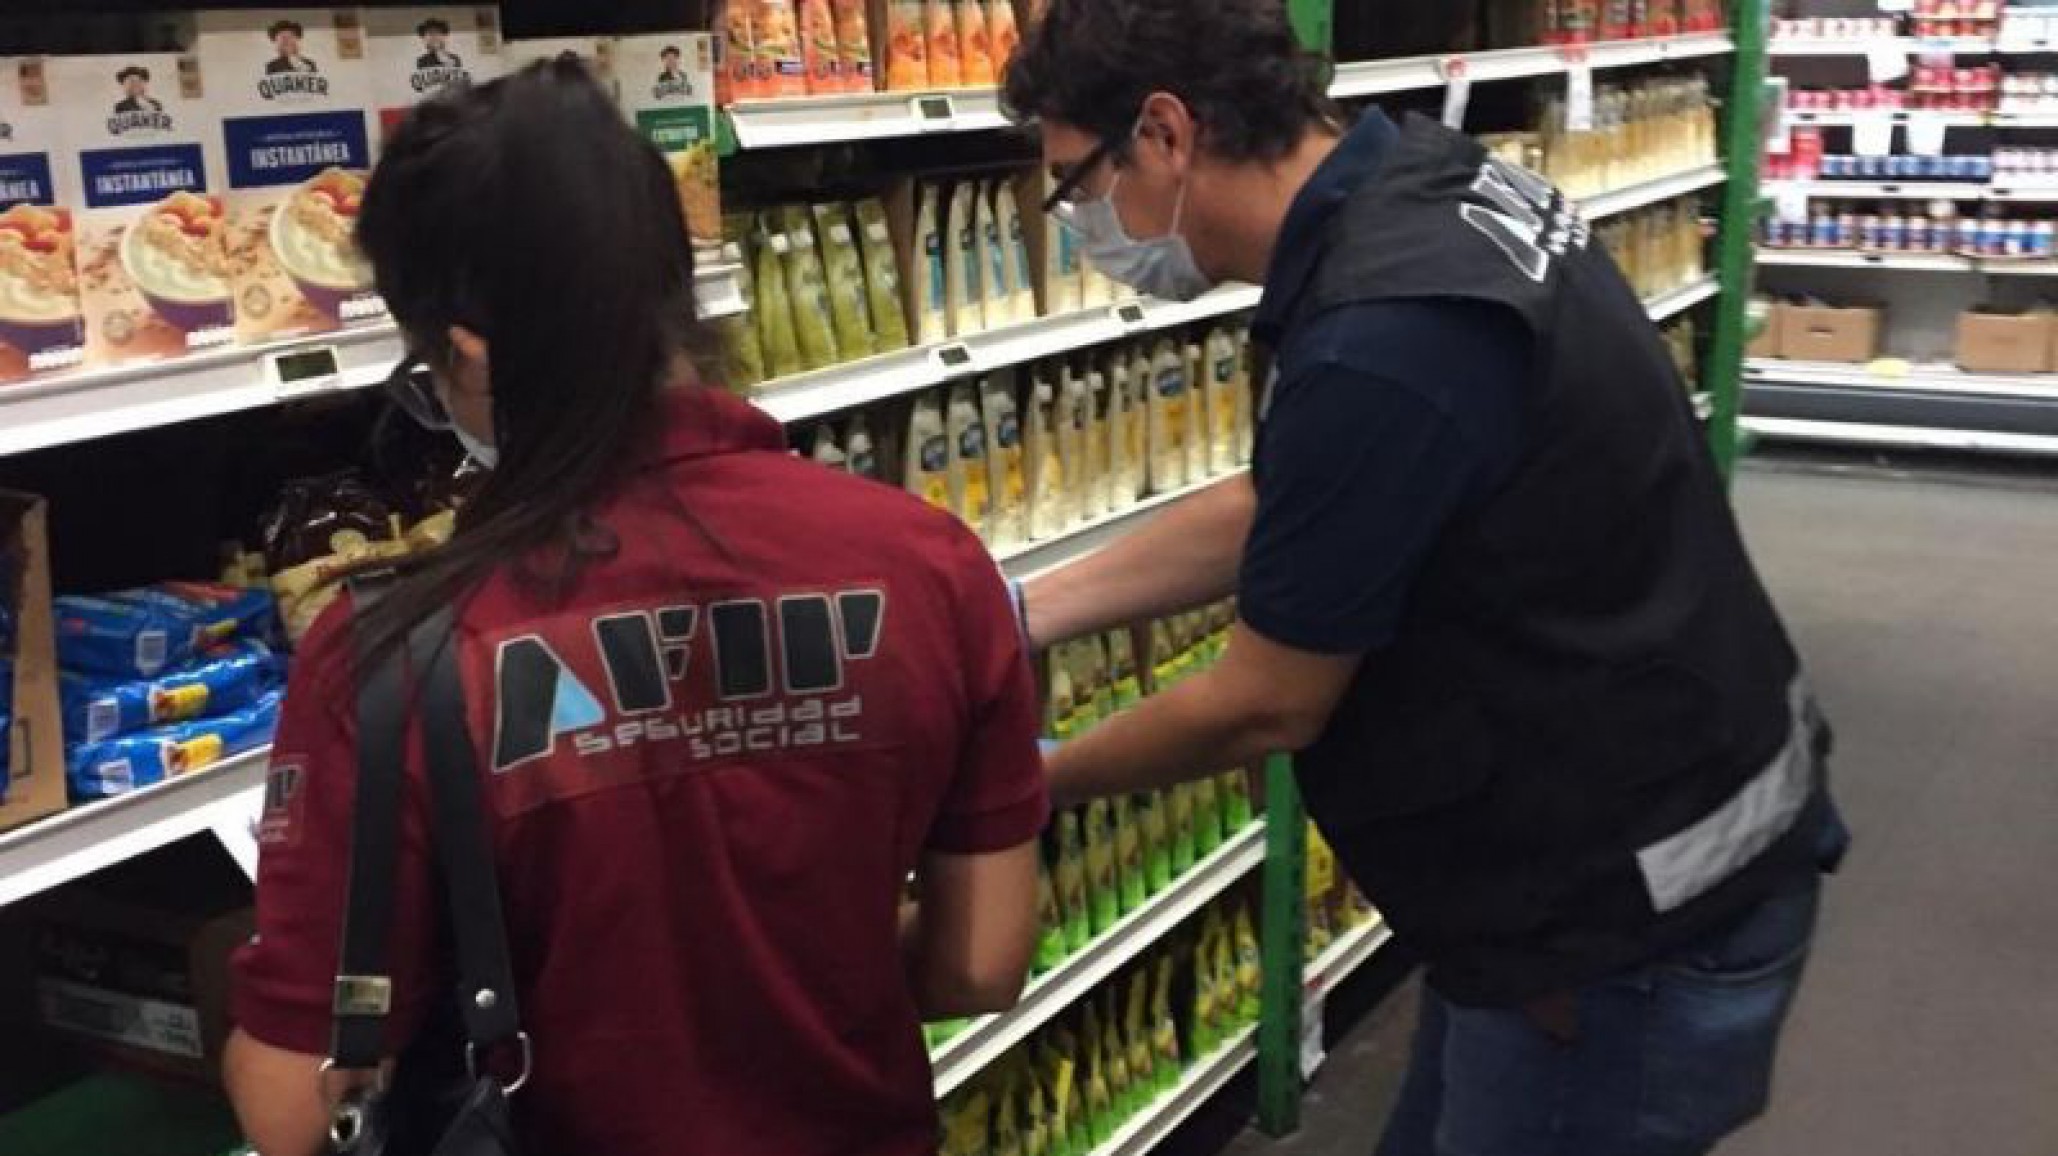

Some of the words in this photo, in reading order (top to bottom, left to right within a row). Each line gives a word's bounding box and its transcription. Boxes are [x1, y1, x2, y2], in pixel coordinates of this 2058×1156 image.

[257, 76, 328, 100] QUAKER
[107, 111, 172, 136] QUAKER
[492, 588, 885, 773] AFIP
